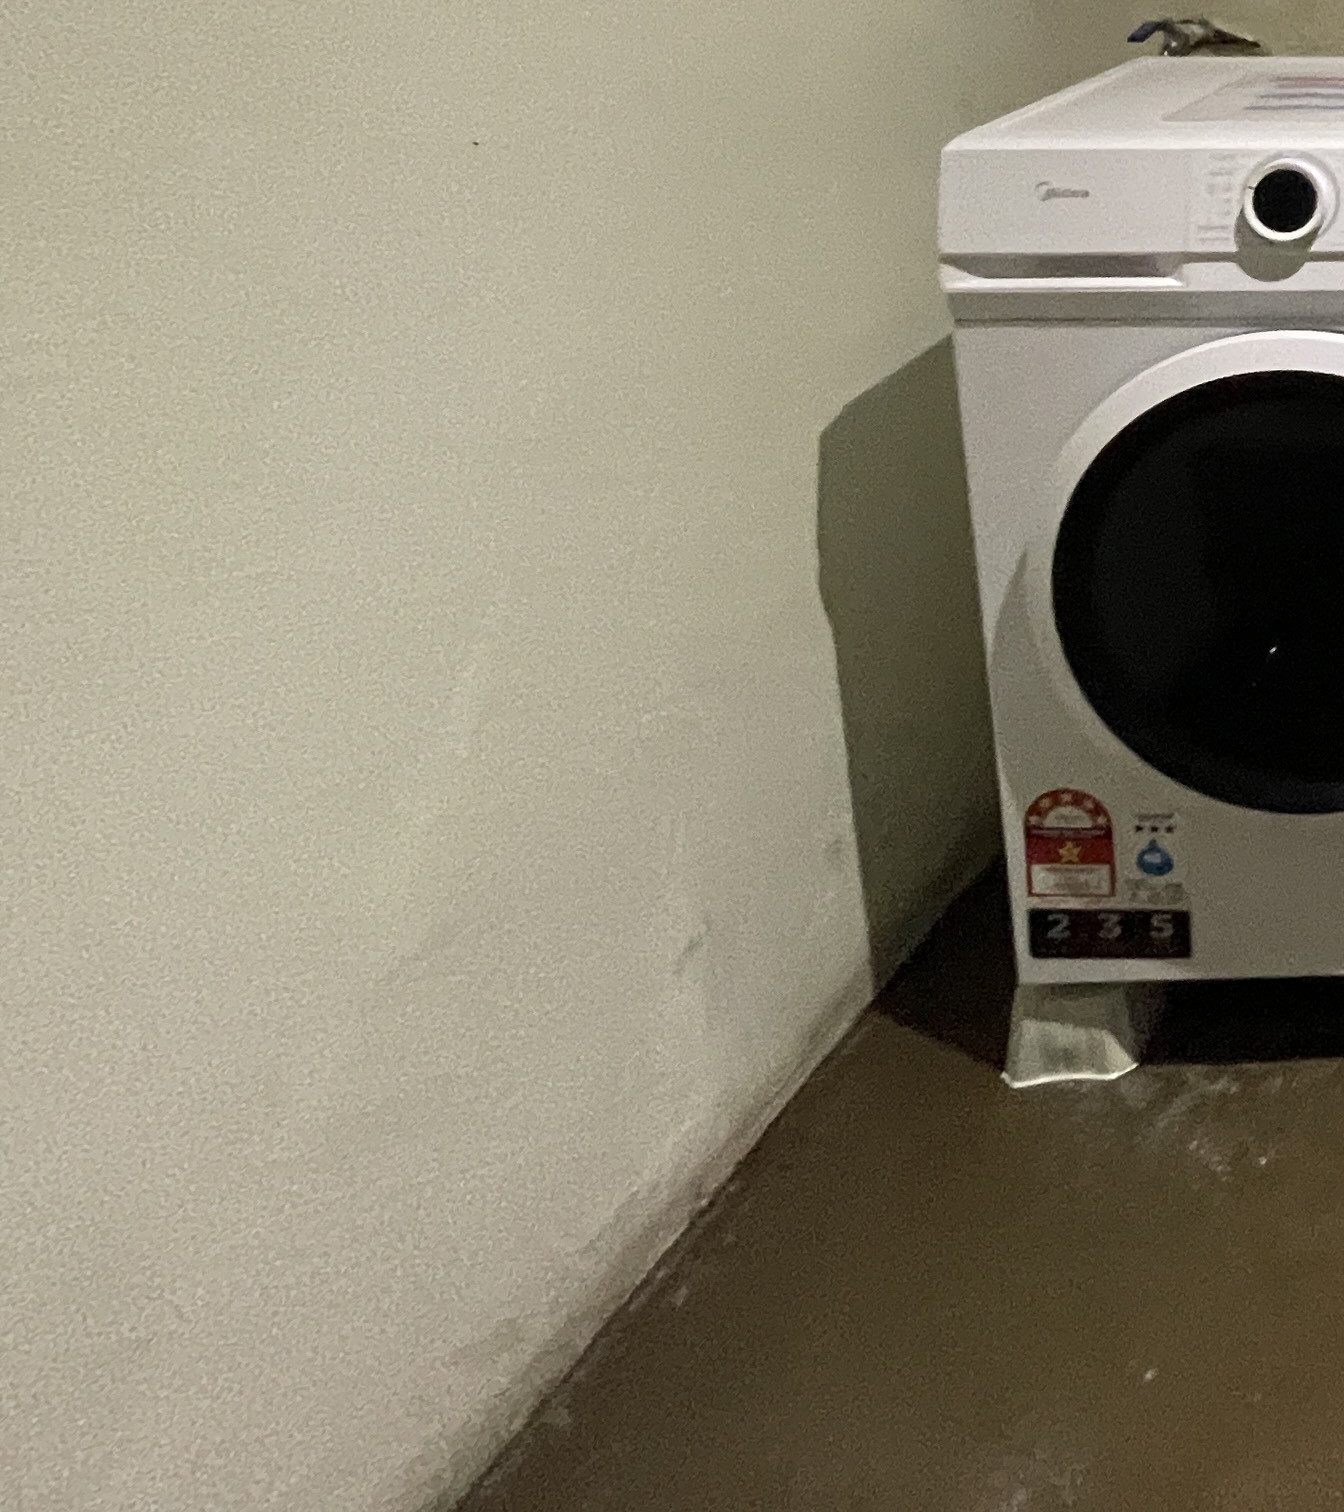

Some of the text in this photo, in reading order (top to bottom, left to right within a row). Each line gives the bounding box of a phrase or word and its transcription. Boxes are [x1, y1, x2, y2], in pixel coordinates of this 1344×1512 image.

[1047, 913, 1174, 938] 2 3 5
